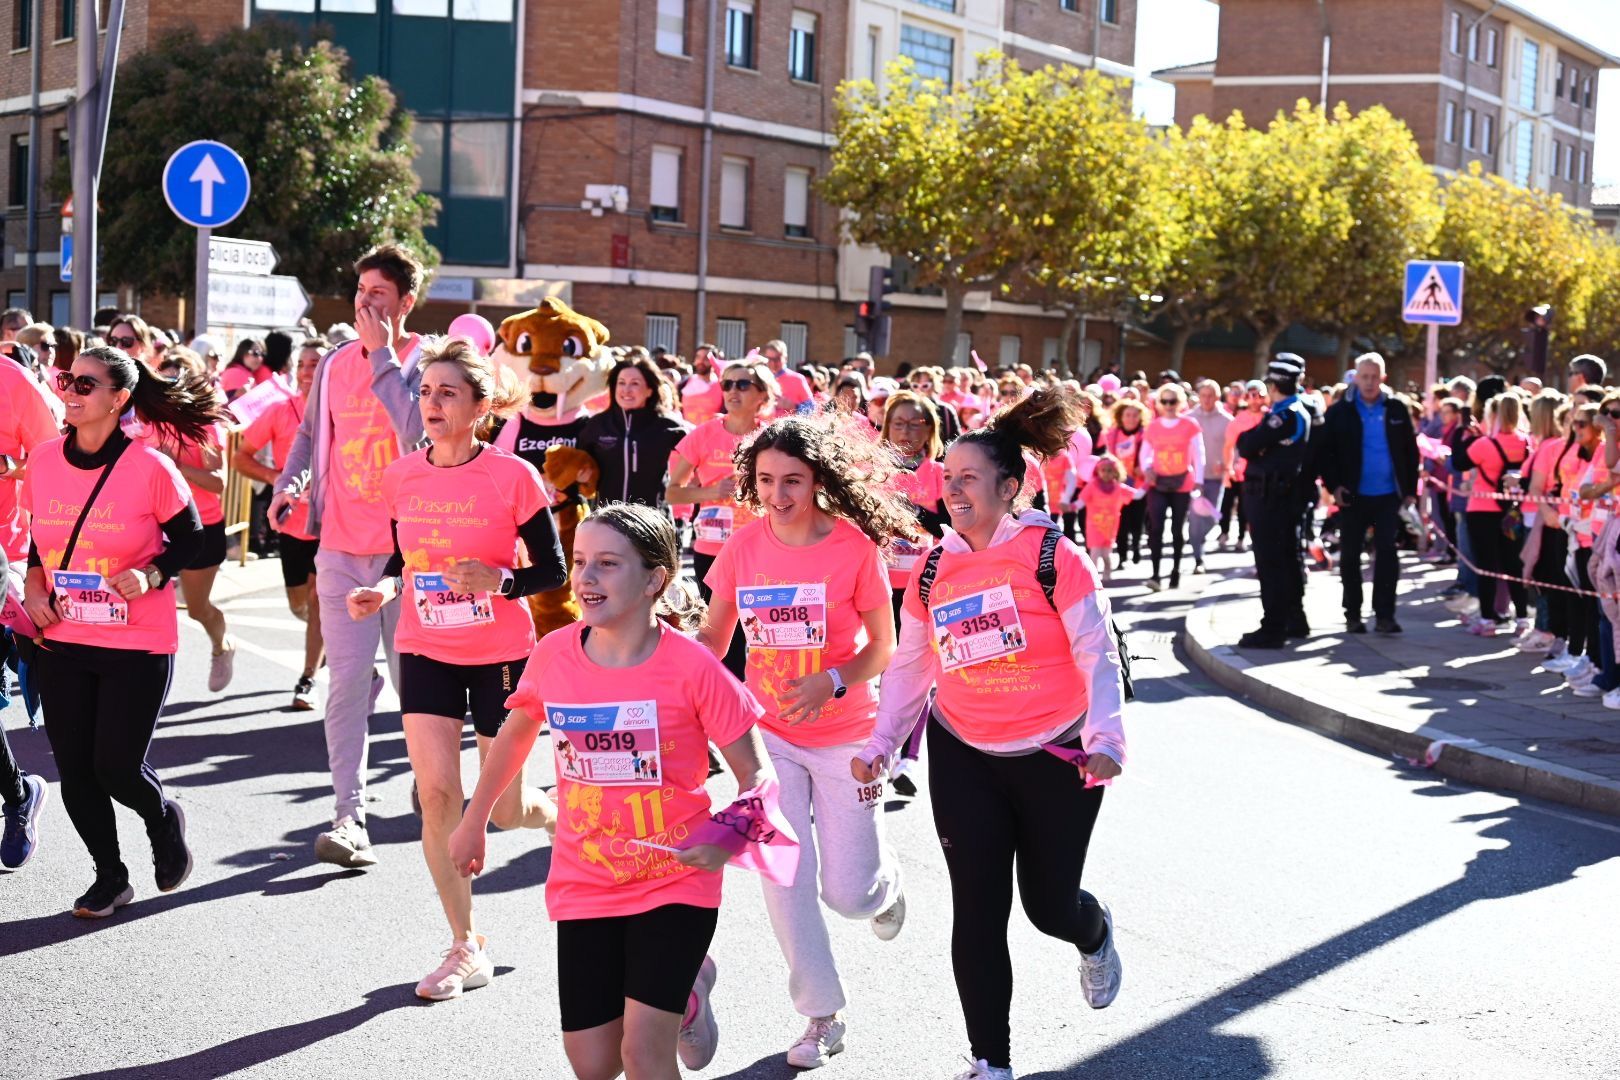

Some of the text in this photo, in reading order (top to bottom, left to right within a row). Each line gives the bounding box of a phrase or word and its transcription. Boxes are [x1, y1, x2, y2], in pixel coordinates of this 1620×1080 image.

[79, 590, 110, 603] 4157
[769, 606, 809, 622] 0518
[961, 612, 1001, 635] 3153
[976, 684, 1041, 694] DRASANVI
[552, 711, 566, 726] hp
[585, 732, 635, 751] 0519
[857, 783, 883, 802] 1983
